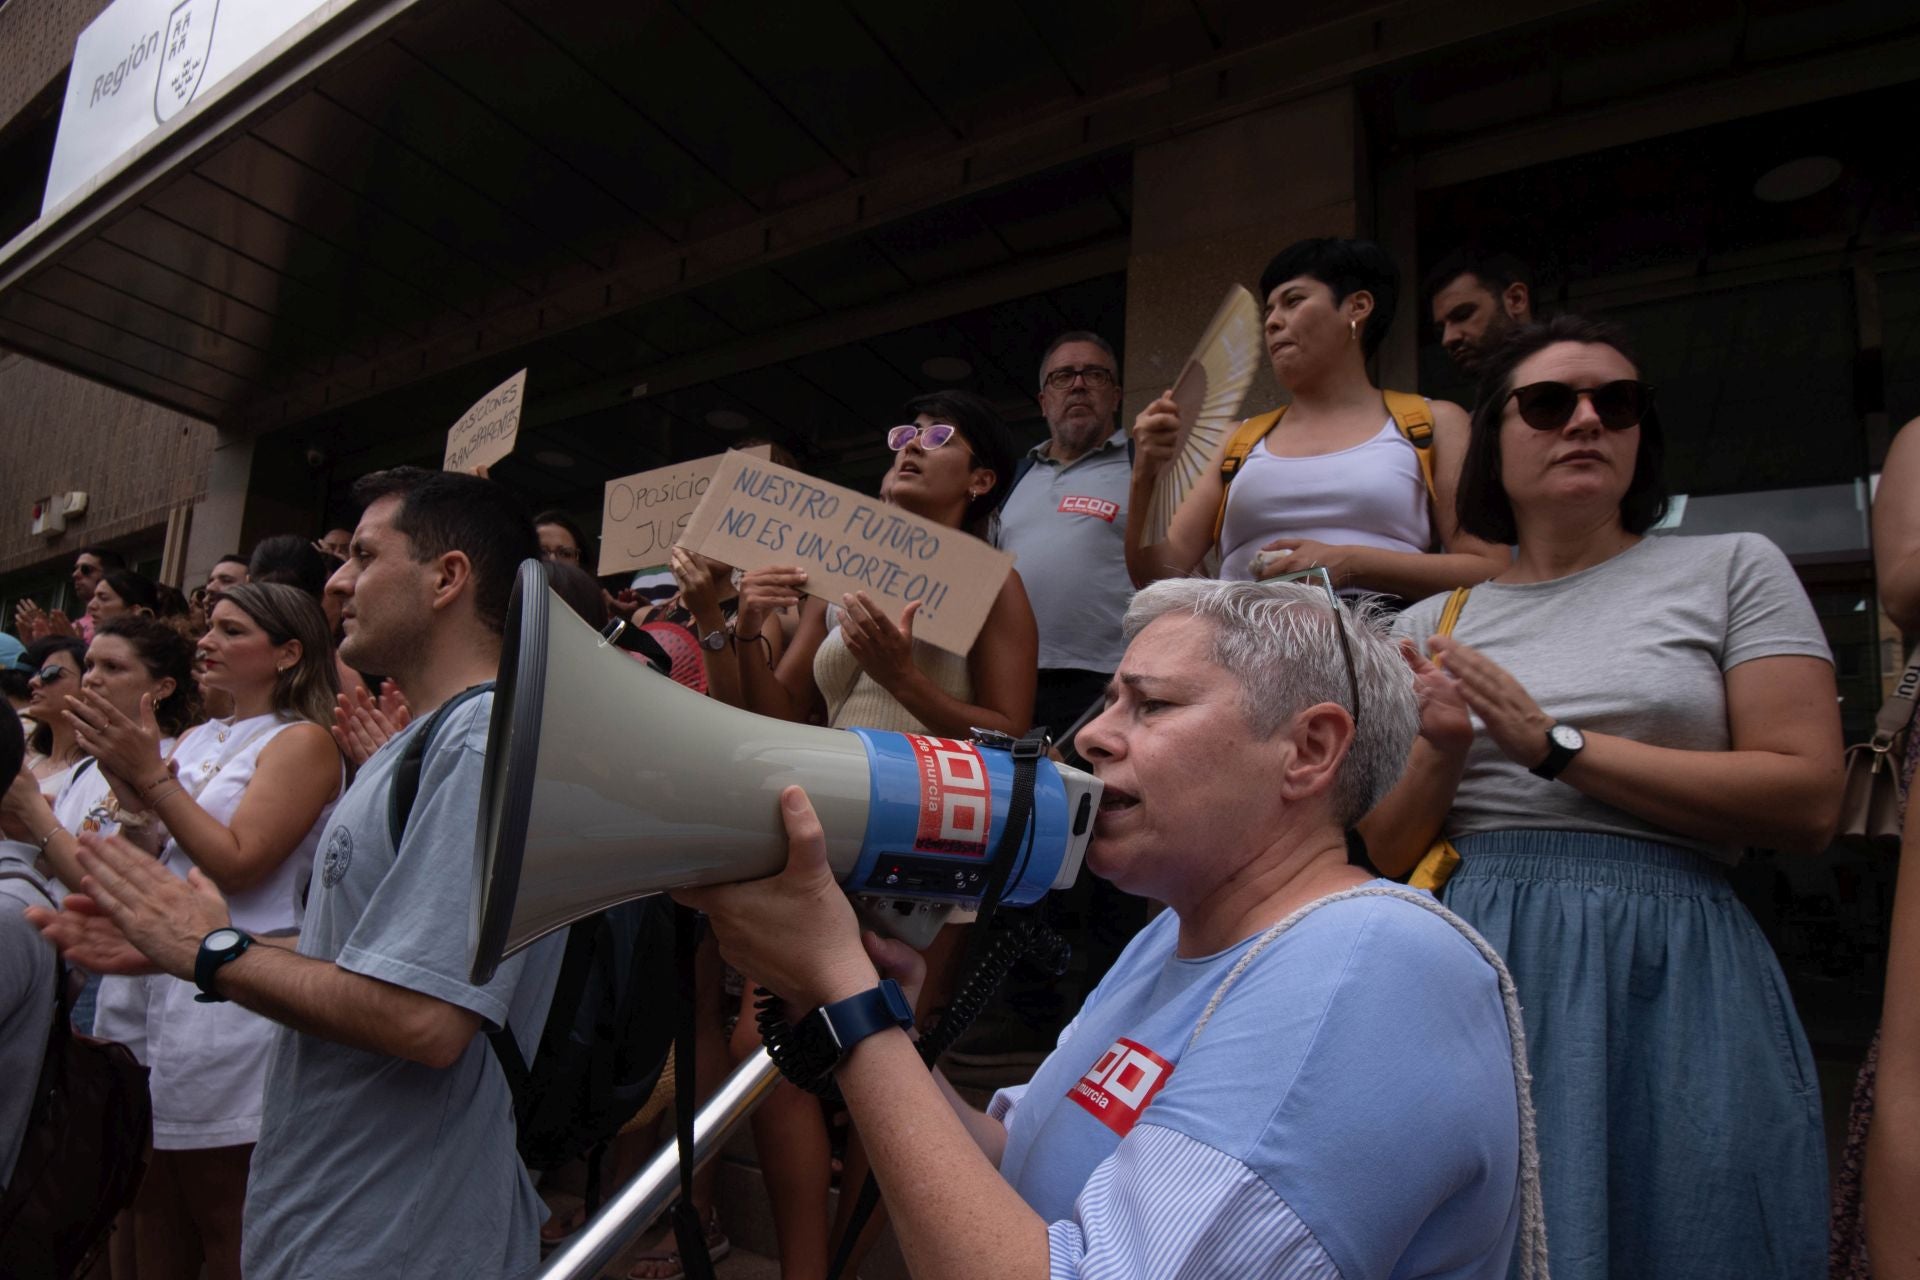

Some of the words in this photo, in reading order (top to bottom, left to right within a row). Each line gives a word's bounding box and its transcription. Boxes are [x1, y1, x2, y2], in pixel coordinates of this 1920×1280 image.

[89, 30, 160, 109] Región
[733, 466, 840, 520] NUESTRO
[843, 505, 940, 561] FUTURO
[1063, 496, 1116, 516] CCOO
[717, 507, 757, 538] NO
[756, 517, 793, 551] ES
[795, 531, 833, 562] UN
[825, 545, 949, 620] SORTEO!!
[923, 755, 941, 812] murcia
[1078, 1083, 1110, 1110] murcia
